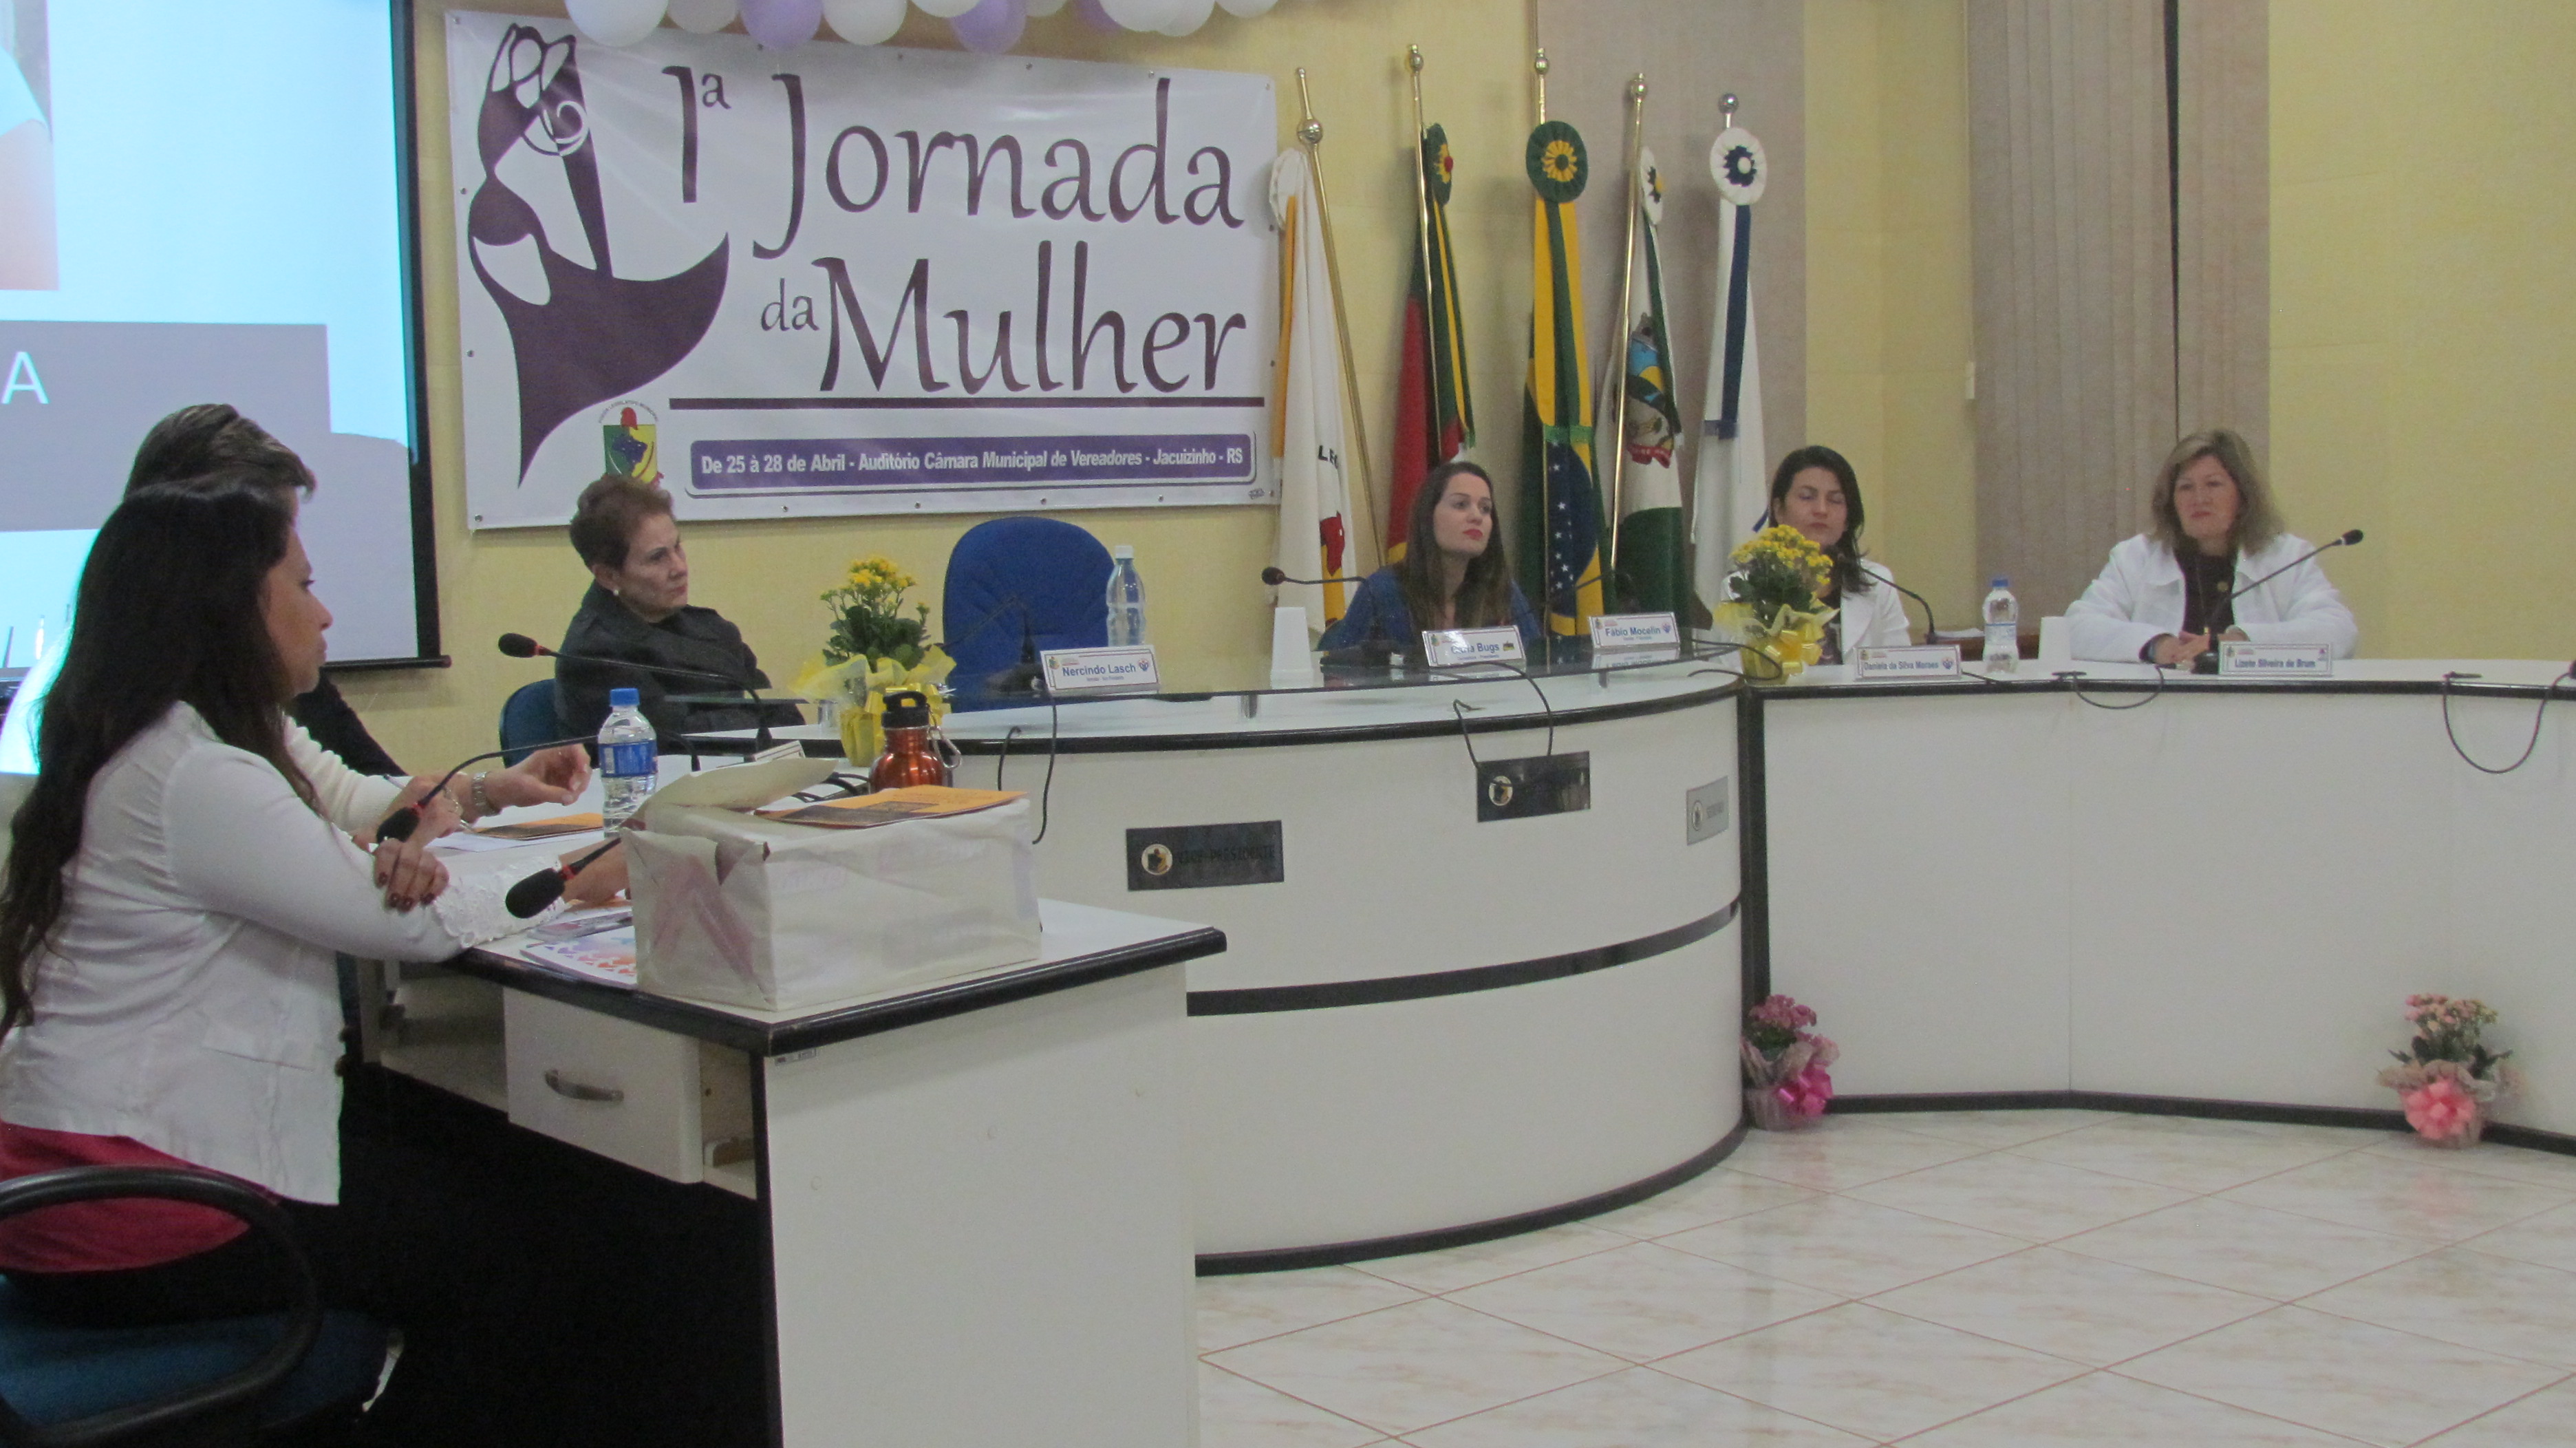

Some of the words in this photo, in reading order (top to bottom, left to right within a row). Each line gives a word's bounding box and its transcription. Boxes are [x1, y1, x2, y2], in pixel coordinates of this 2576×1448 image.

[753, 72, 1244, 259] Jornada
[761, 279, 819, 332] da
[812, 241, 1246, 394] Mulher
[702, 456, 722, 474] De
[727, 455, 746, 473] 25
[750, 456, 760, 473] à
[764, 454, 782, 473] 28
[786, 454, 806, 472] de
[811, 454, 846, 472] Abril
[859, 451, 920, 471] Auditório
[924, 451, 978, 469] Câmara
[983, 451, 1047, 472] Municipal
[1051, 450, 1067, 467] de
[1071, 449, 1142, 466] Vereadores
[1153, 448, 1216, 465] Jacuizinho
[1227, 447, 1243, 464] RS
[1477, 643, 1500, 654] Bugs
[1062, 665, 1106, 677] Nercindo
[1108, 663, 1137, 674] Lasch
